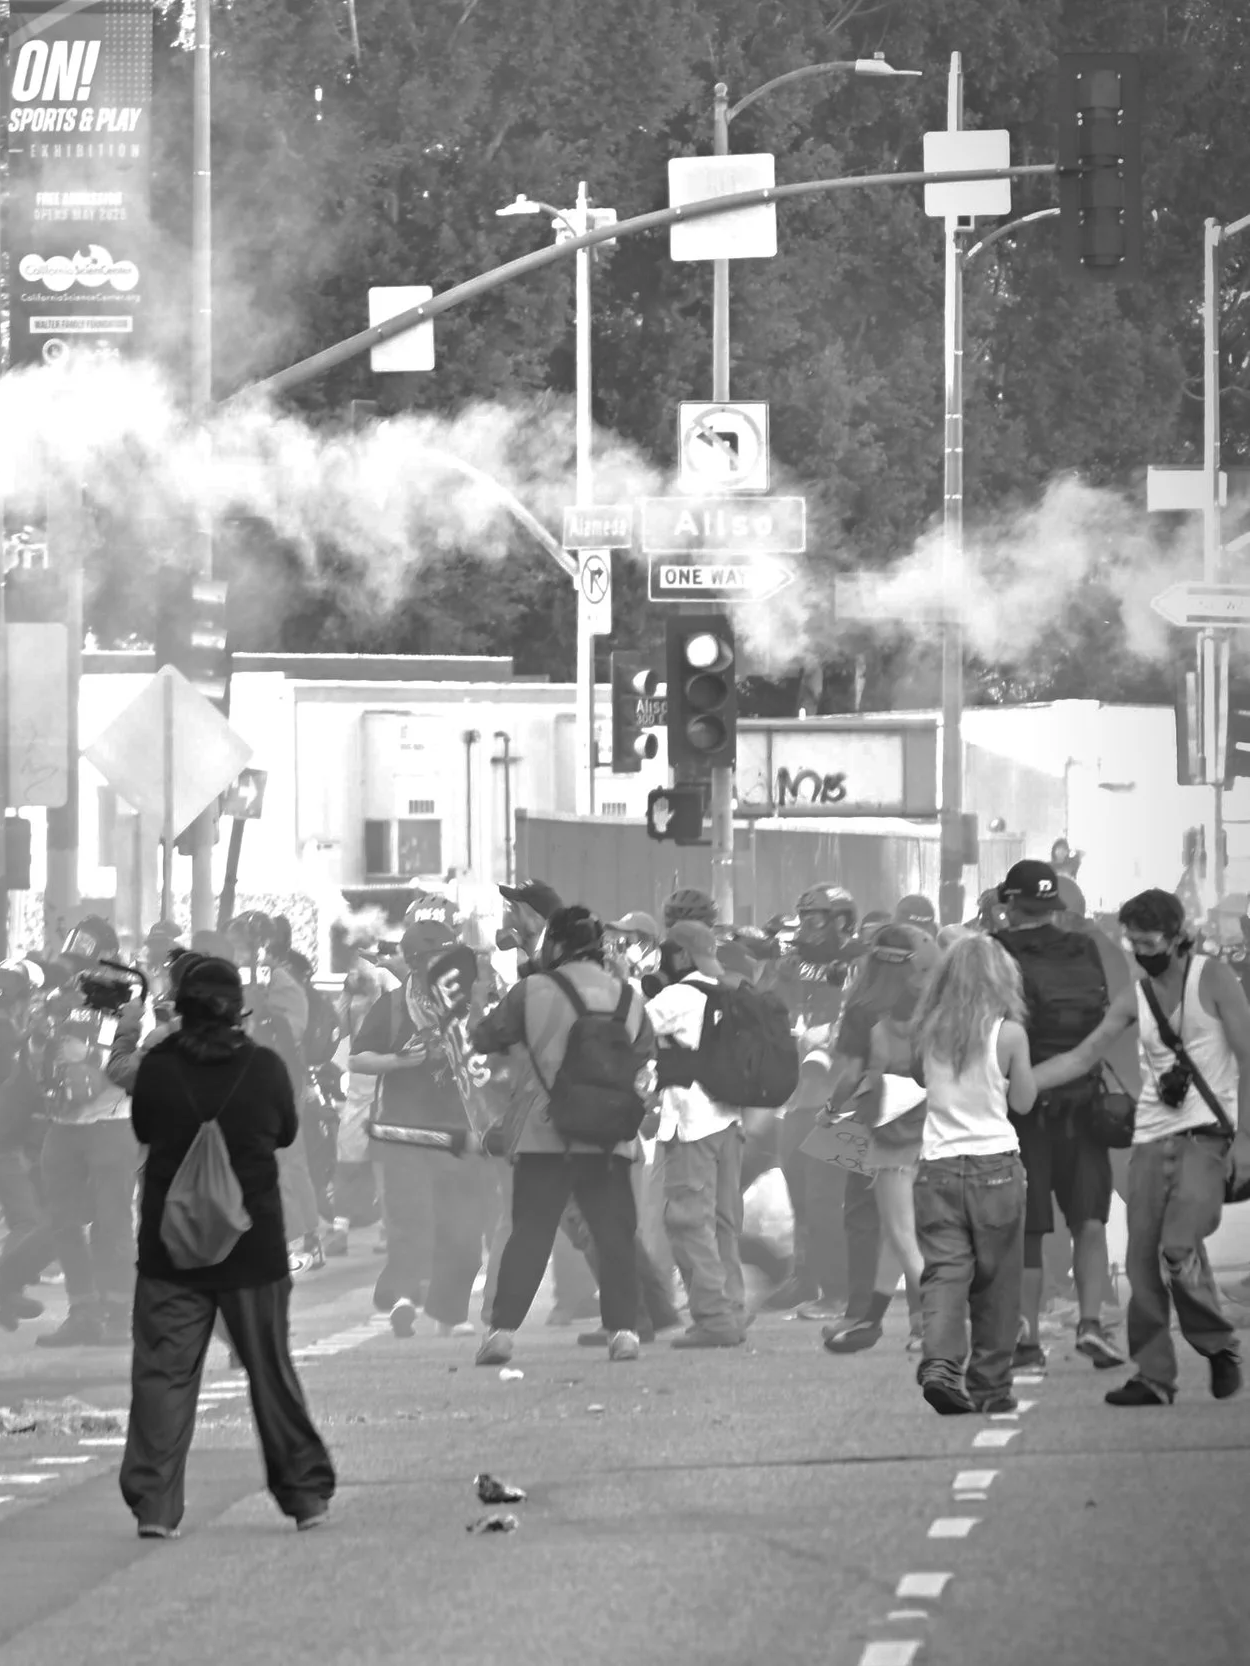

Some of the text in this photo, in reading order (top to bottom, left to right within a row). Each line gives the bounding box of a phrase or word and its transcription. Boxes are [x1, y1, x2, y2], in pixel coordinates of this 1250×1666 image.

[11, 40, 101, 102] ON!
[8, 107, 76, 132] SPORTS
[79, 108, 92, 132] &
[95, 107, 142, 132] PLAY
[30, 143, 140, 158] EXHIBITION
[673, 509, 773, 536] Aliso
[664, 568, 747, 585] ONE WAY
